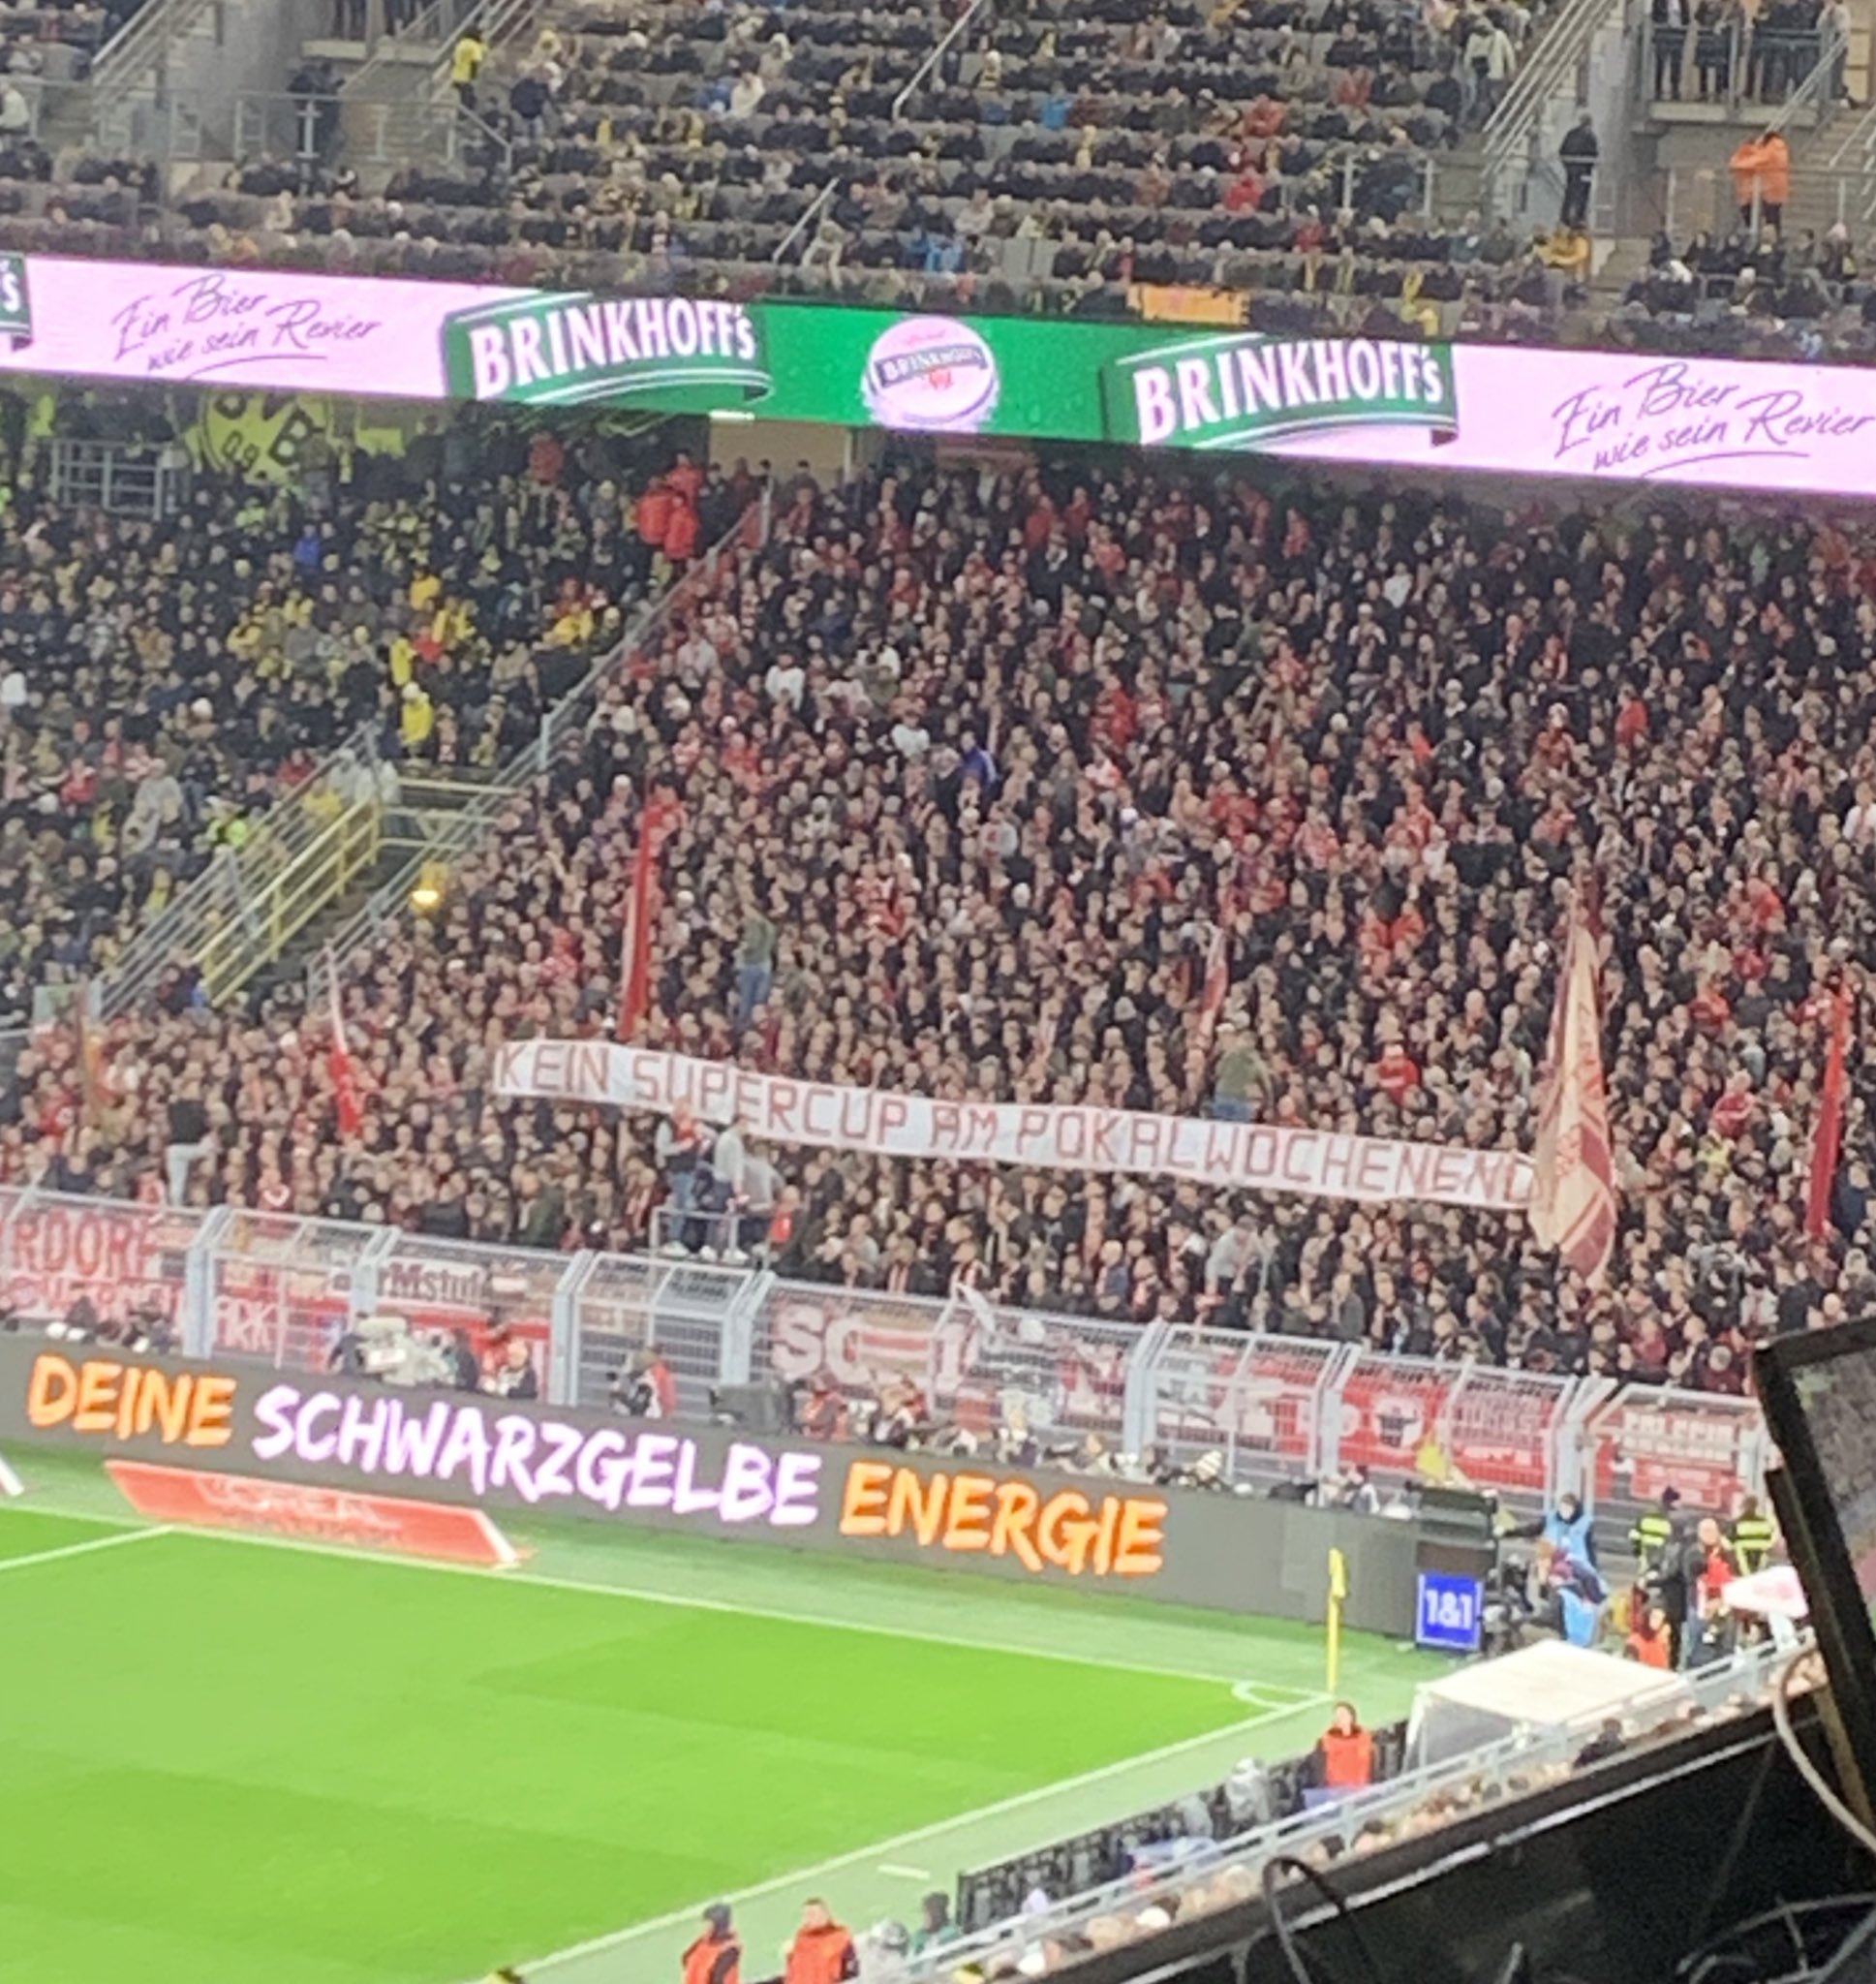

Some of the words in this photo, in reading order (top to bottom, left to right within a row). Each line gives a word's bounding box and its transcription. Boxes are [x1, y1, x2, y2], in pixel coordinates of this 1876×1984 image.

[111, 294, 170, 361] Ein
[171, 272, 267, 323] Bier
[147, 338, 194, 371] wie
[201, 321, 259, 355] sein
[264, 298, 383, 350] Revier
[1552, 386, 1621, 459] Ein
[1623, 361, 1739, 419] Bier
[1593, 433, 1649, 471] wie
[1657, 417, 1728, 451] sein
[1735, 389, 1875, 447] Revier
[498, 1042, 610, 1094] KEIN
[633, 1054, 907, 1146] SUPERCUP
[930, 1103, 998, 1152] AM
[28, 1357, 235, 1445] DEINE
[252, 1385, 822, 1527] SCHWARZGELBE
[840, 1460, 1168, 1577] ENERGIE
[1426, 1589, 1473, 1630] 1&1
